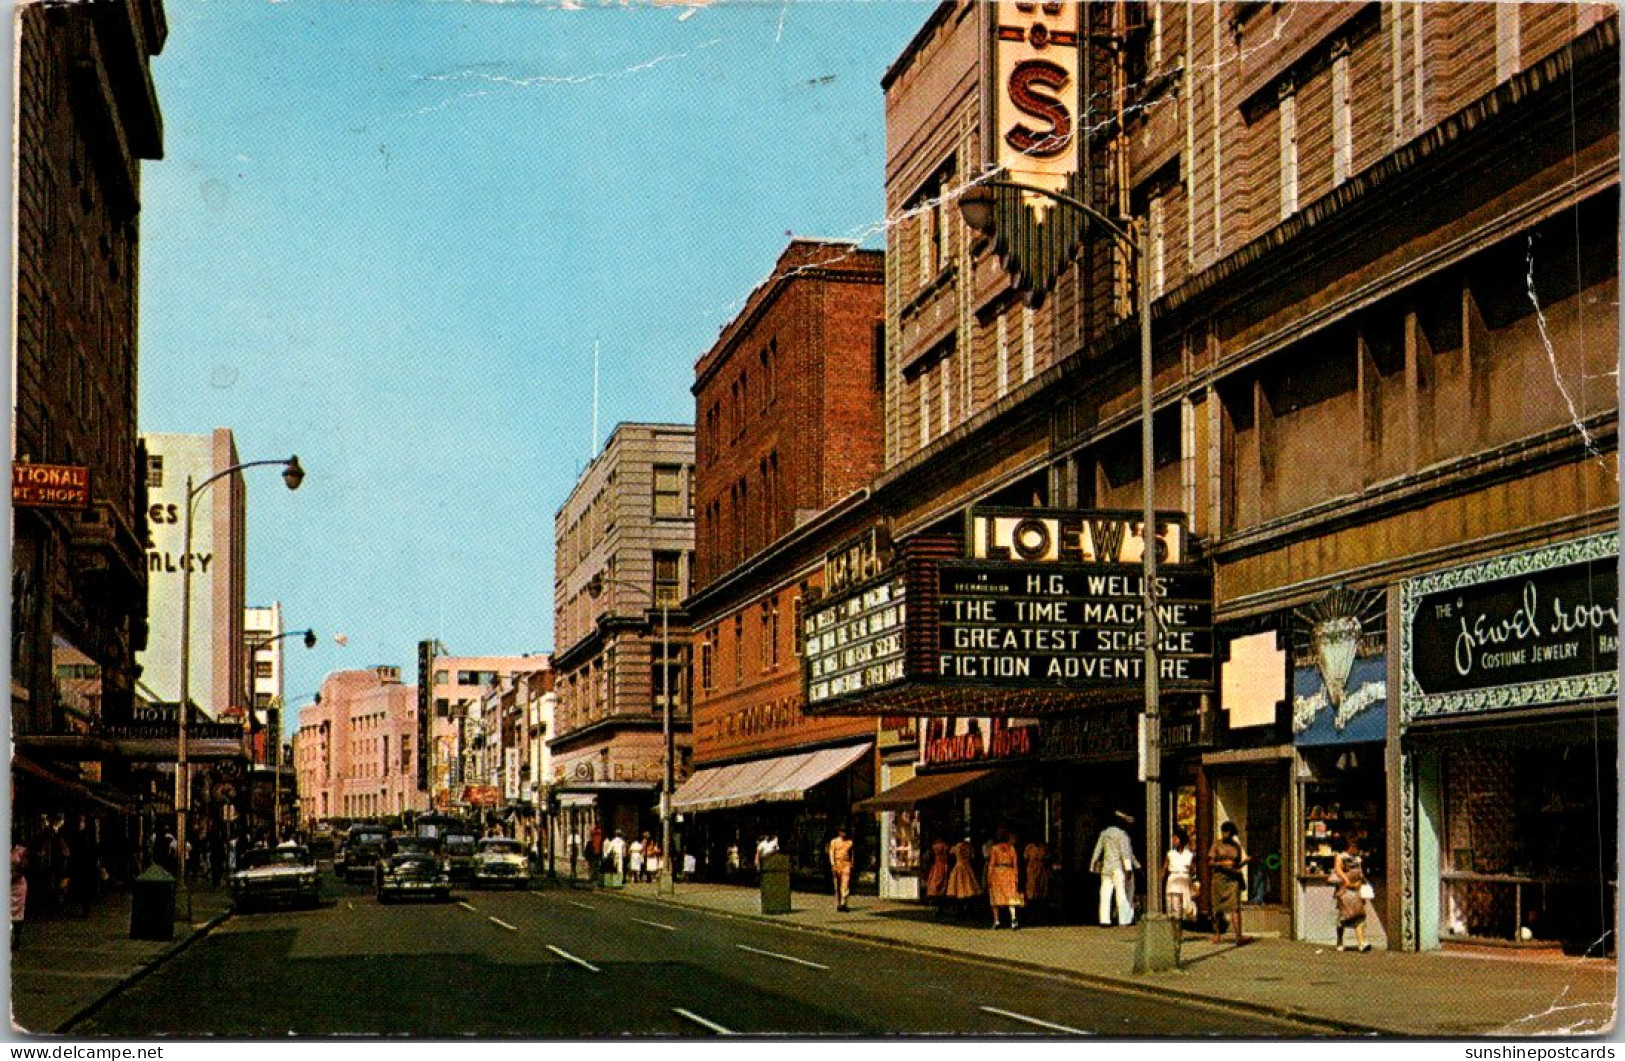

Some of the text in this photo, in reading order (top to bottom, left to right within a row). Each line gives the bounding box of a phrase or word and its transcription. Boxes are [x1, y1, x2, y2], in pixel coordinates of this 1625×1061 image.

[985, 517, 1169, 562] LOEW'S
[1026, 574, 1175, 596] H.G. WELLS'
[939, 600, 1199, 625] "THE TIME MACHNE"
[1435, 603, 1453, 619] THE
[954, 628, 1080, 650] GREATEST
[940, 655, 1190, 679] FICTION ADVENTRE
[133, 707, 182, 722] HOT
